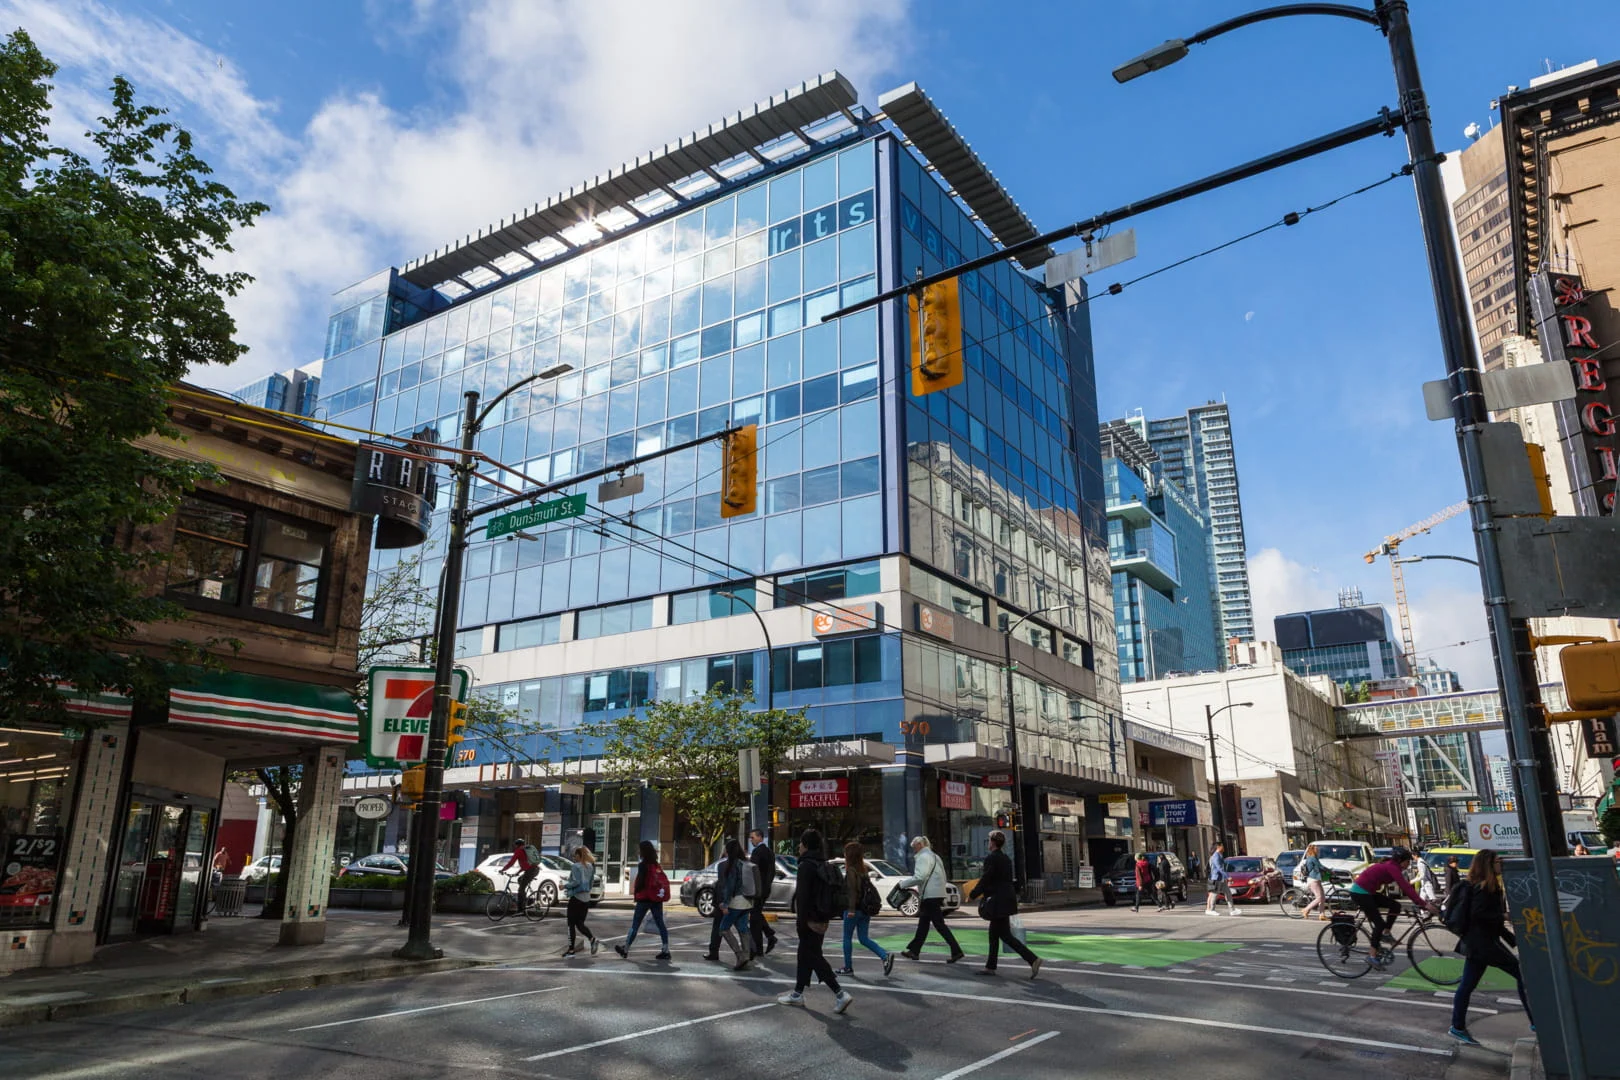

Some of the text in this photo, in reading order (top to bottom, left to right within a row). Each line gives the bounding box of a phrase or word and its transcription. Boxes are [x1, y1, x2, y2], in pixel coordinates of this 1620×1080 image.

[509, 501, 576, 529] Dunsmuir St.
[384, 718, 429, 734] ELEVE
[899, 720, 930, 736] 570
[457, 749, 475, 762] 570
[800, 793, 840, 802] PEACEFUL
[358, 803, 384, 812] PROPER
[1493, 823, 1521, 836] Cana
